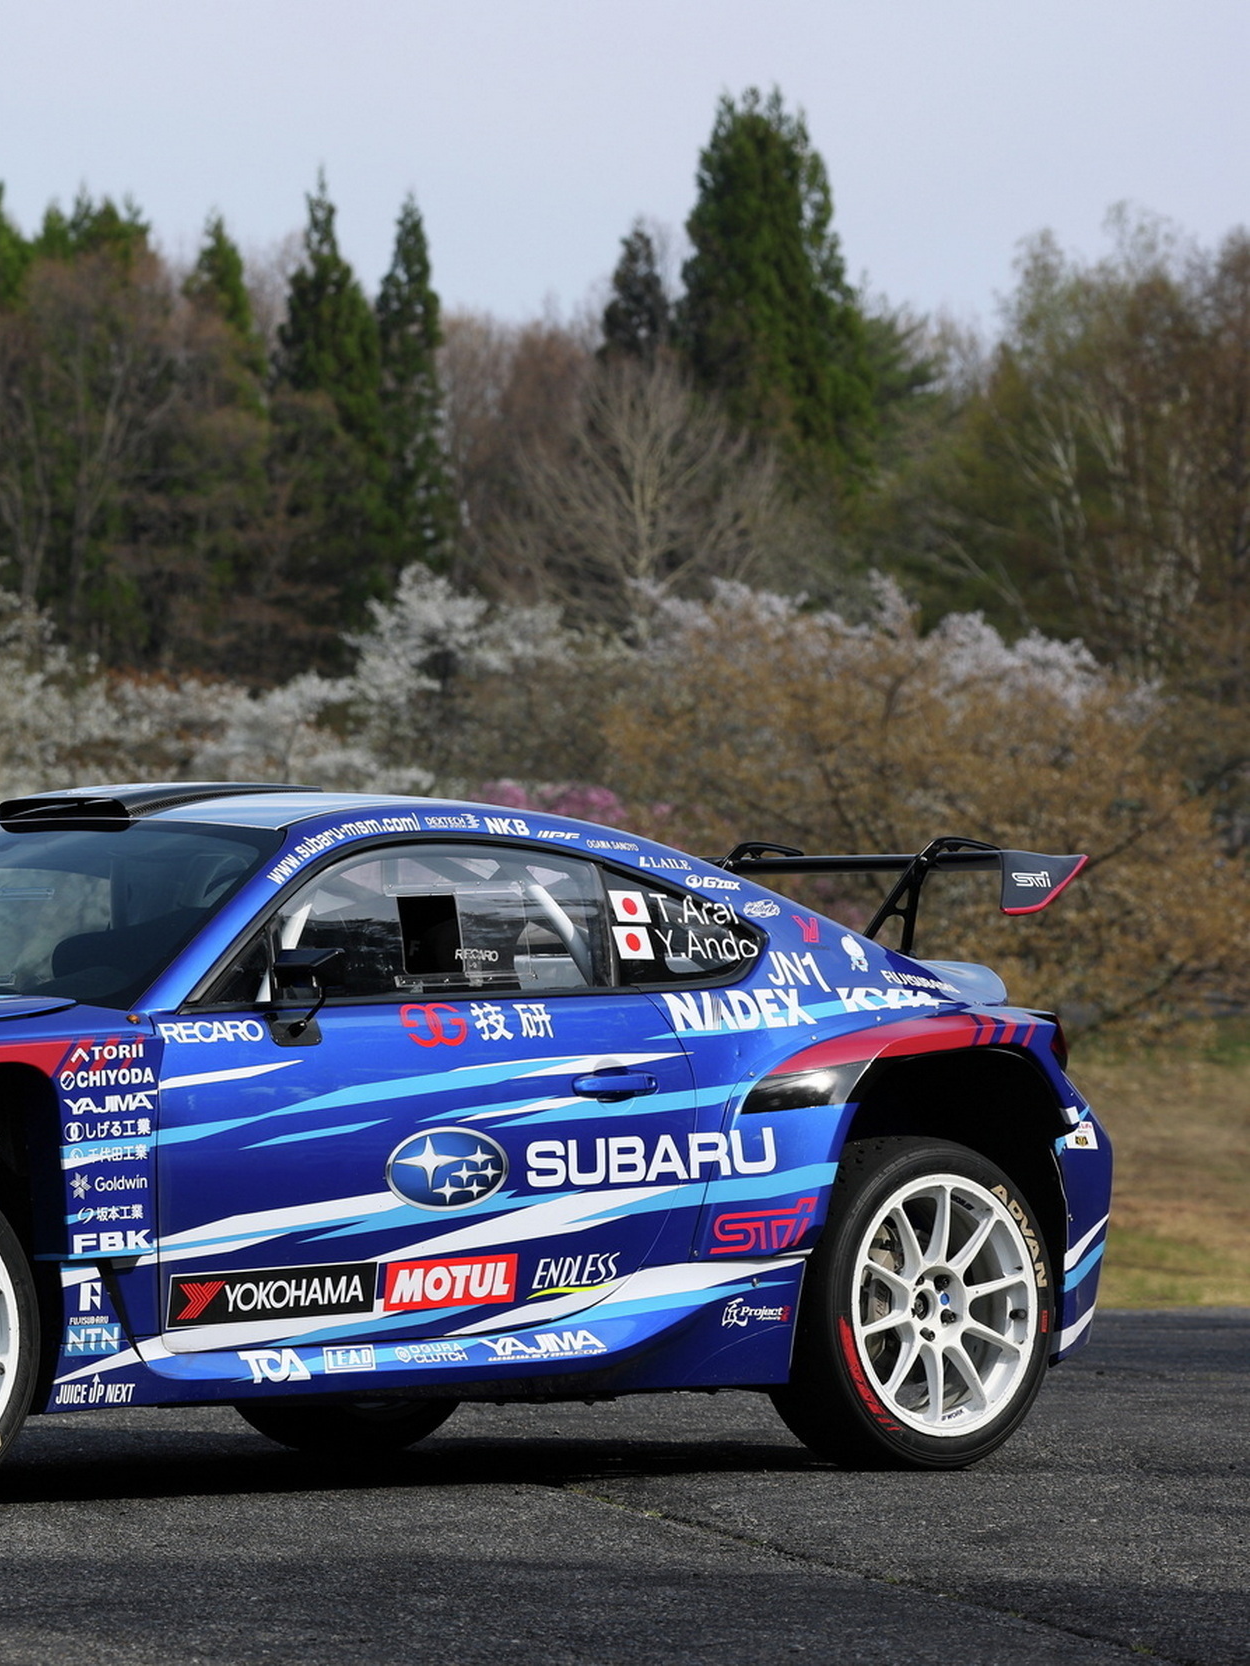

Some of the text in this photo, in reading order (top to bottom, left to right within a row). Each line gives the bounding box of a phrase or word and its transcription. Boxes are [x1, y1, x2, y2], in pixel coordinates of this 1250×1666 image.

[483, 817, 530, 836] NKB
[650, 857, 692, 870] LAILE
[648, 894, 739, 925] T.Arai
[454, 948, 499, 962] RECARO
[654, 929, 759, 961] Y.Ando
[767, 951, 832, 992] JN1
[661, 988, 818, 1033] NADEX
[157, 1020, 264, 1044] RECARO
[91, 1043, 144, 1061] TORII
[76, 1067, 155, 1089] CHIYODA
[63, 1093, 154, 1115] YAJIMA
[85, 1118, 151, 1139] しげる工業
[526, 1127, 777, 1188] SUBARU
[94, 1174, 148, 1192] Goldwin
[73, 1229, 151, 1254] FBK
[990, 1184, 1048, 1288] ADVAN
[390, 1261, 511, 1304] MOTUL
[532, 1253, 621, 1290] ENDLESS
[224, 1274, 364, 1312] YOKOHAMA
[67, 1327, 119, 1353] NTN
[409, 1342, 464, 1354] OGURA
[478, 1330, 607, 1356] YAJIMA
[238, 1348, 311, 1384] TOA
[327, 1349, 372, 1367] LEAD
[414, 1350, 468, 1363] CLUTCH
[55, 1384, 88, 1404] JUICE
[104, 1383, 136, 1402] NEXT
